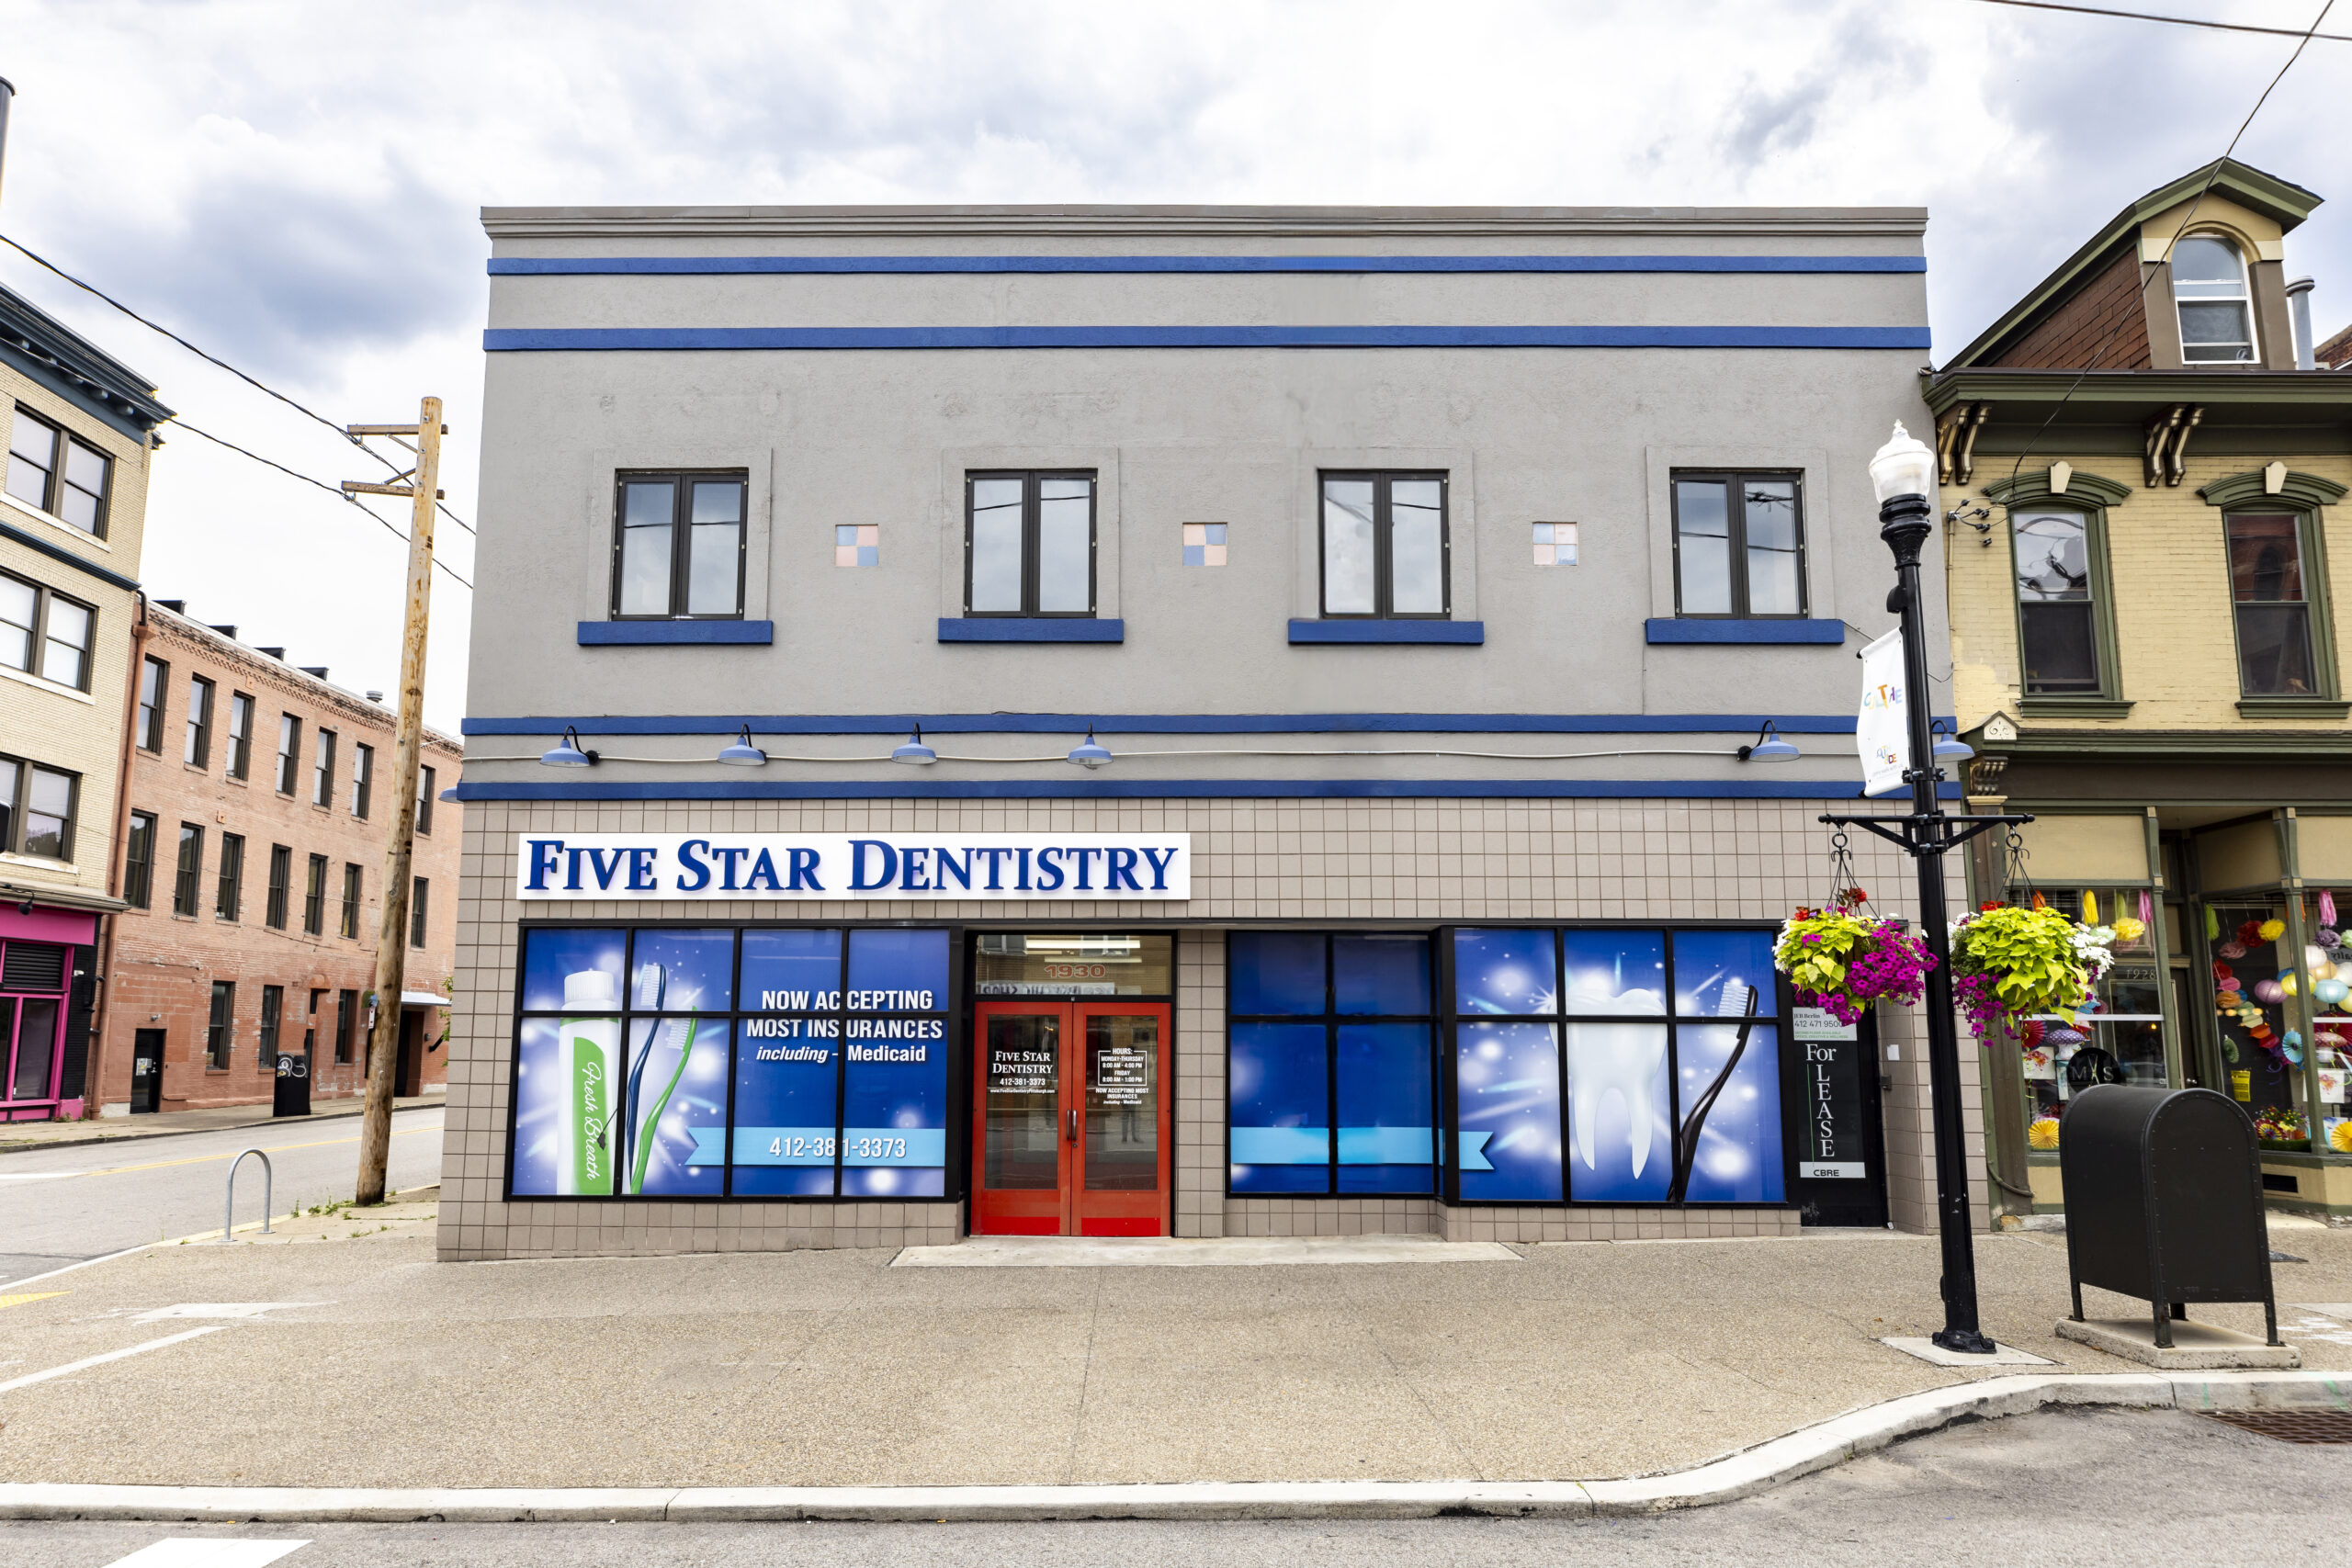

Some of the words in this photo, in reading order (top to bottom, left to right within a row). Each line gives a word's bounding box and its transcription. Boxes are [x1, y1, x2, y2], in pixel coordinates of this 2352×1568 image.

[525, 840, 658, 890] FIVE
[676, 839, 825, 891] STAR
[846, 840, 1179, 891] DENTISTRY
[1044, 965, 1106, 978] 1930
[2126, 969, 2157, 980] 1928
[762, 990, 809, 1010] NOW
[814, 990, 933, 1010] ACCEPTING
[746, 1019, 802, 1037] MOST
[807, 1019, 943, 1039] INSURANCES
[756, 1045, 829, 1064] including
[847, 1044, 926, 1062] Medicaid
[995, 1051, 1021, 1062] FIVE
[1023, 1051, 1051, 1062] STAR
[1112, 1047, 1133, 1055] HOURS:
[1805, 1043, 1837, 1061] For
[992, 1063, 1053, 1074] DENTISTRY
[582, 1061, 603, 1113] Fresh
[1000, 1077, 1046, 1086] 412-381-3373
[1815, 1065, 1835, 1157] LEASE
[583, 1114, 604, 1180] Breath
[769, 1137, 906, 1158] 412-381-3373
[1813, 1168, 1840, 1177] CBRE
